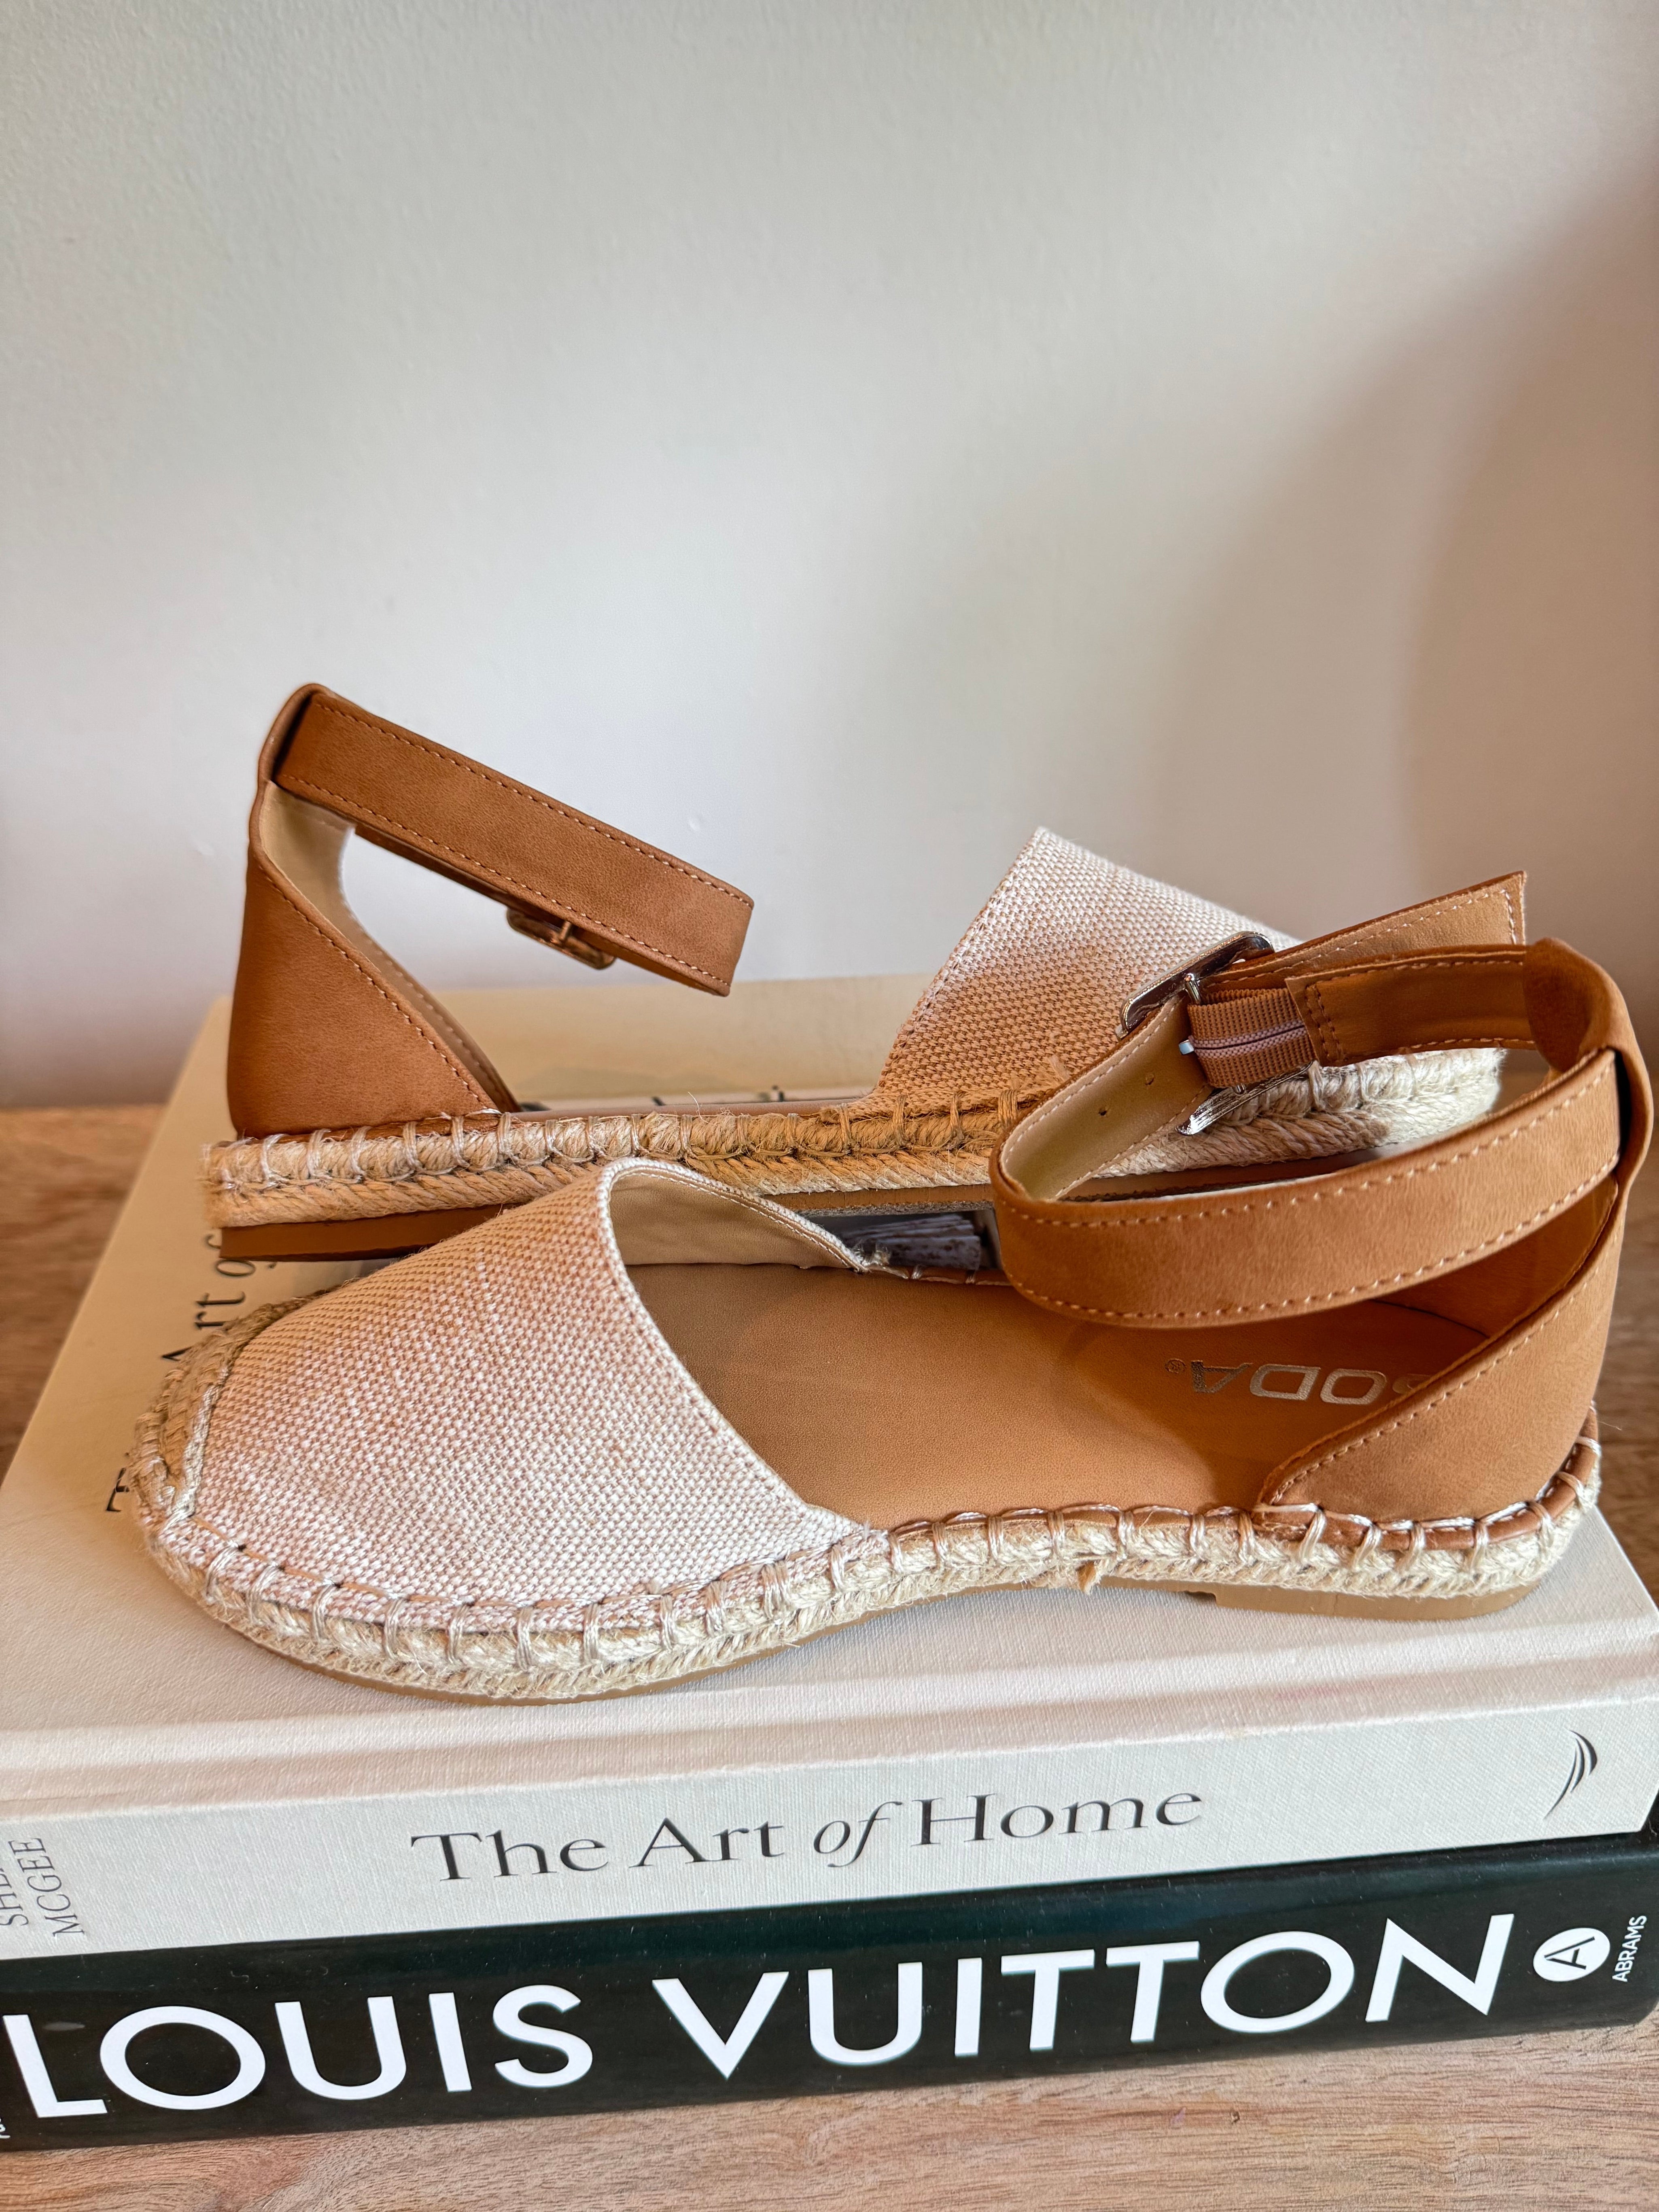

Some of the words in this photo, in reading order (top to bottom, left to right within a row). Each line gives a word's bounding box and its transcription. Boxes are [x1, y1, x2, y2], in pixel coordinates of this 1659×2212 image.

[162, 1293, 246, 1361] rt
[411, 1830, 609, 1881] The
[628, 1817, 784, 1868] Art
[813, 1801, 903, 1868] of
[910, 1792, 1202, 1846] Home
[8, 1838, 85, 1937] MCGEE
[1612, 1915, 1647, 1983] ABRAMS
[2, 1985, 593, 2118] LOUIS
[652, 1913, 1515, 2079] VUITTON
